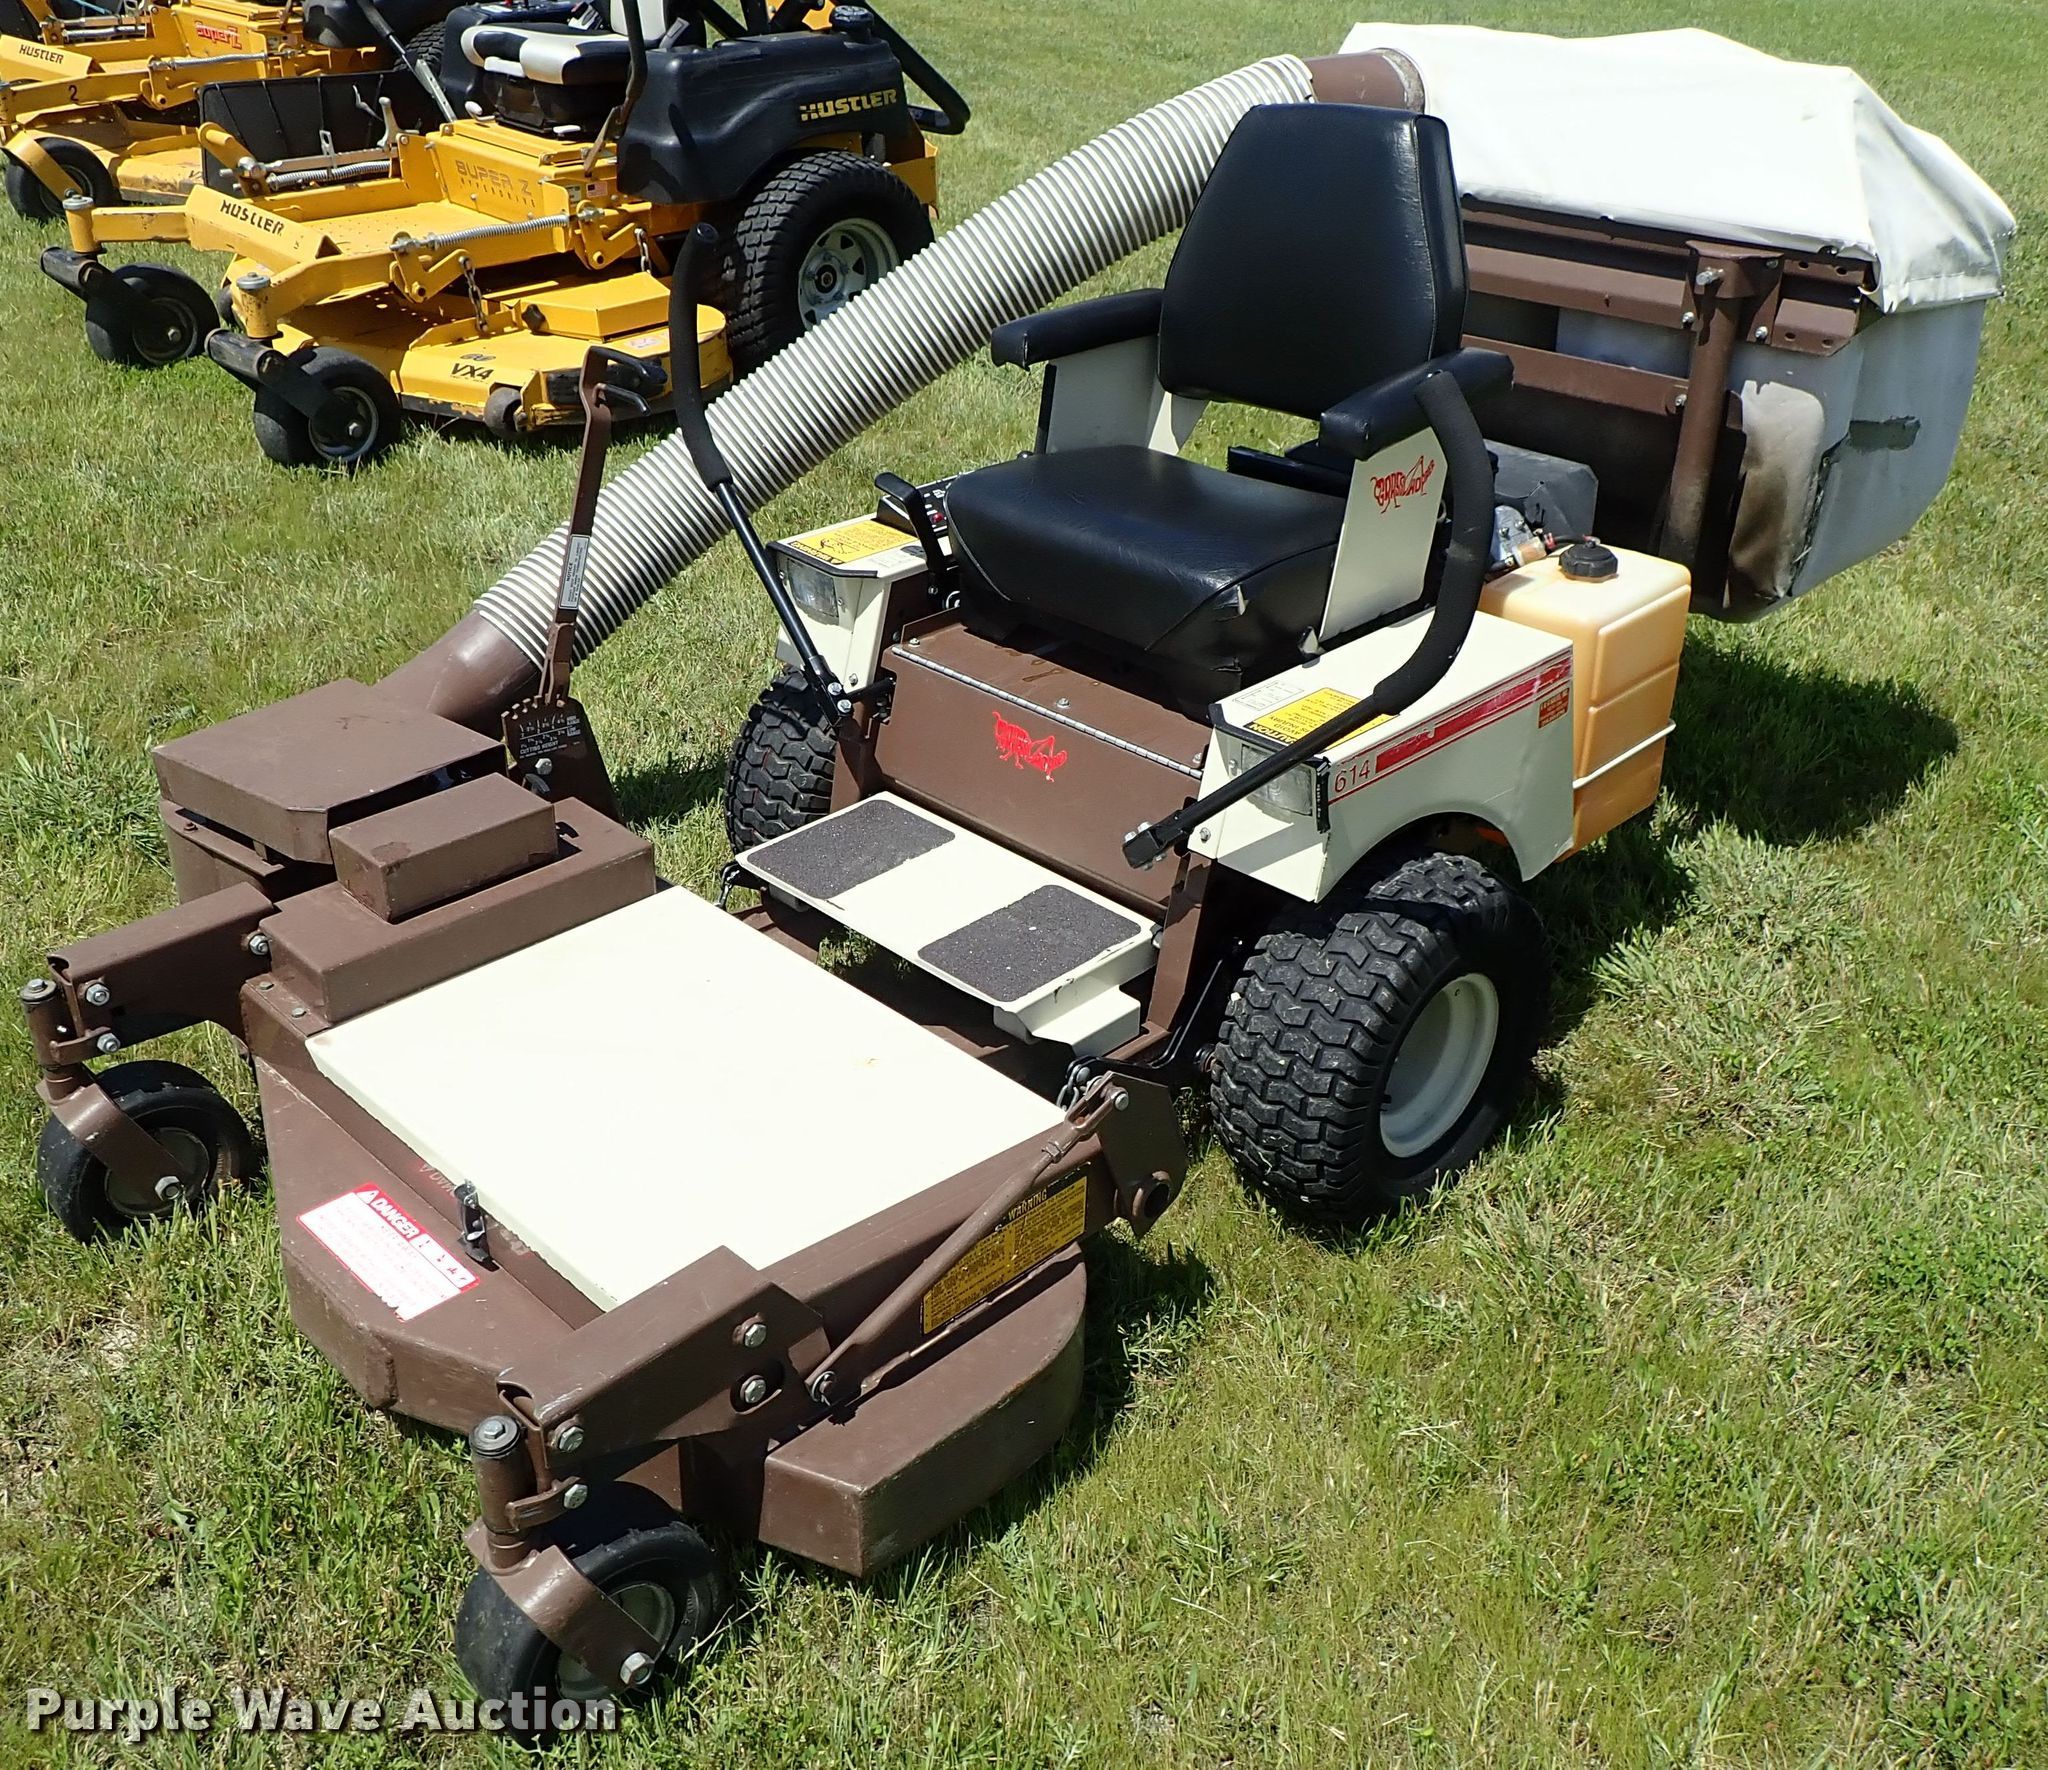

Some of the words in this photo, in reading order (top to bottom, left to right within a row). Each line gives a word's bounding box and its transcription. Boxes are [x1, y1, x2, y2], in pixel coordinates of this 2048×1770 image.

[19, 44, 64, 64] HUSTLER
[68, 85, 79, 101] 2
[800, 89, 897, 121] HUSTLER
[220, 200, 284, 236] HUSTLER
[452, 363, 494, 380] VX4
[1334, 759, 1370, 793] 614
[370, 1198, 419, 1238] DANGER
[1009, 1188, 1048, 1220] WARNING
